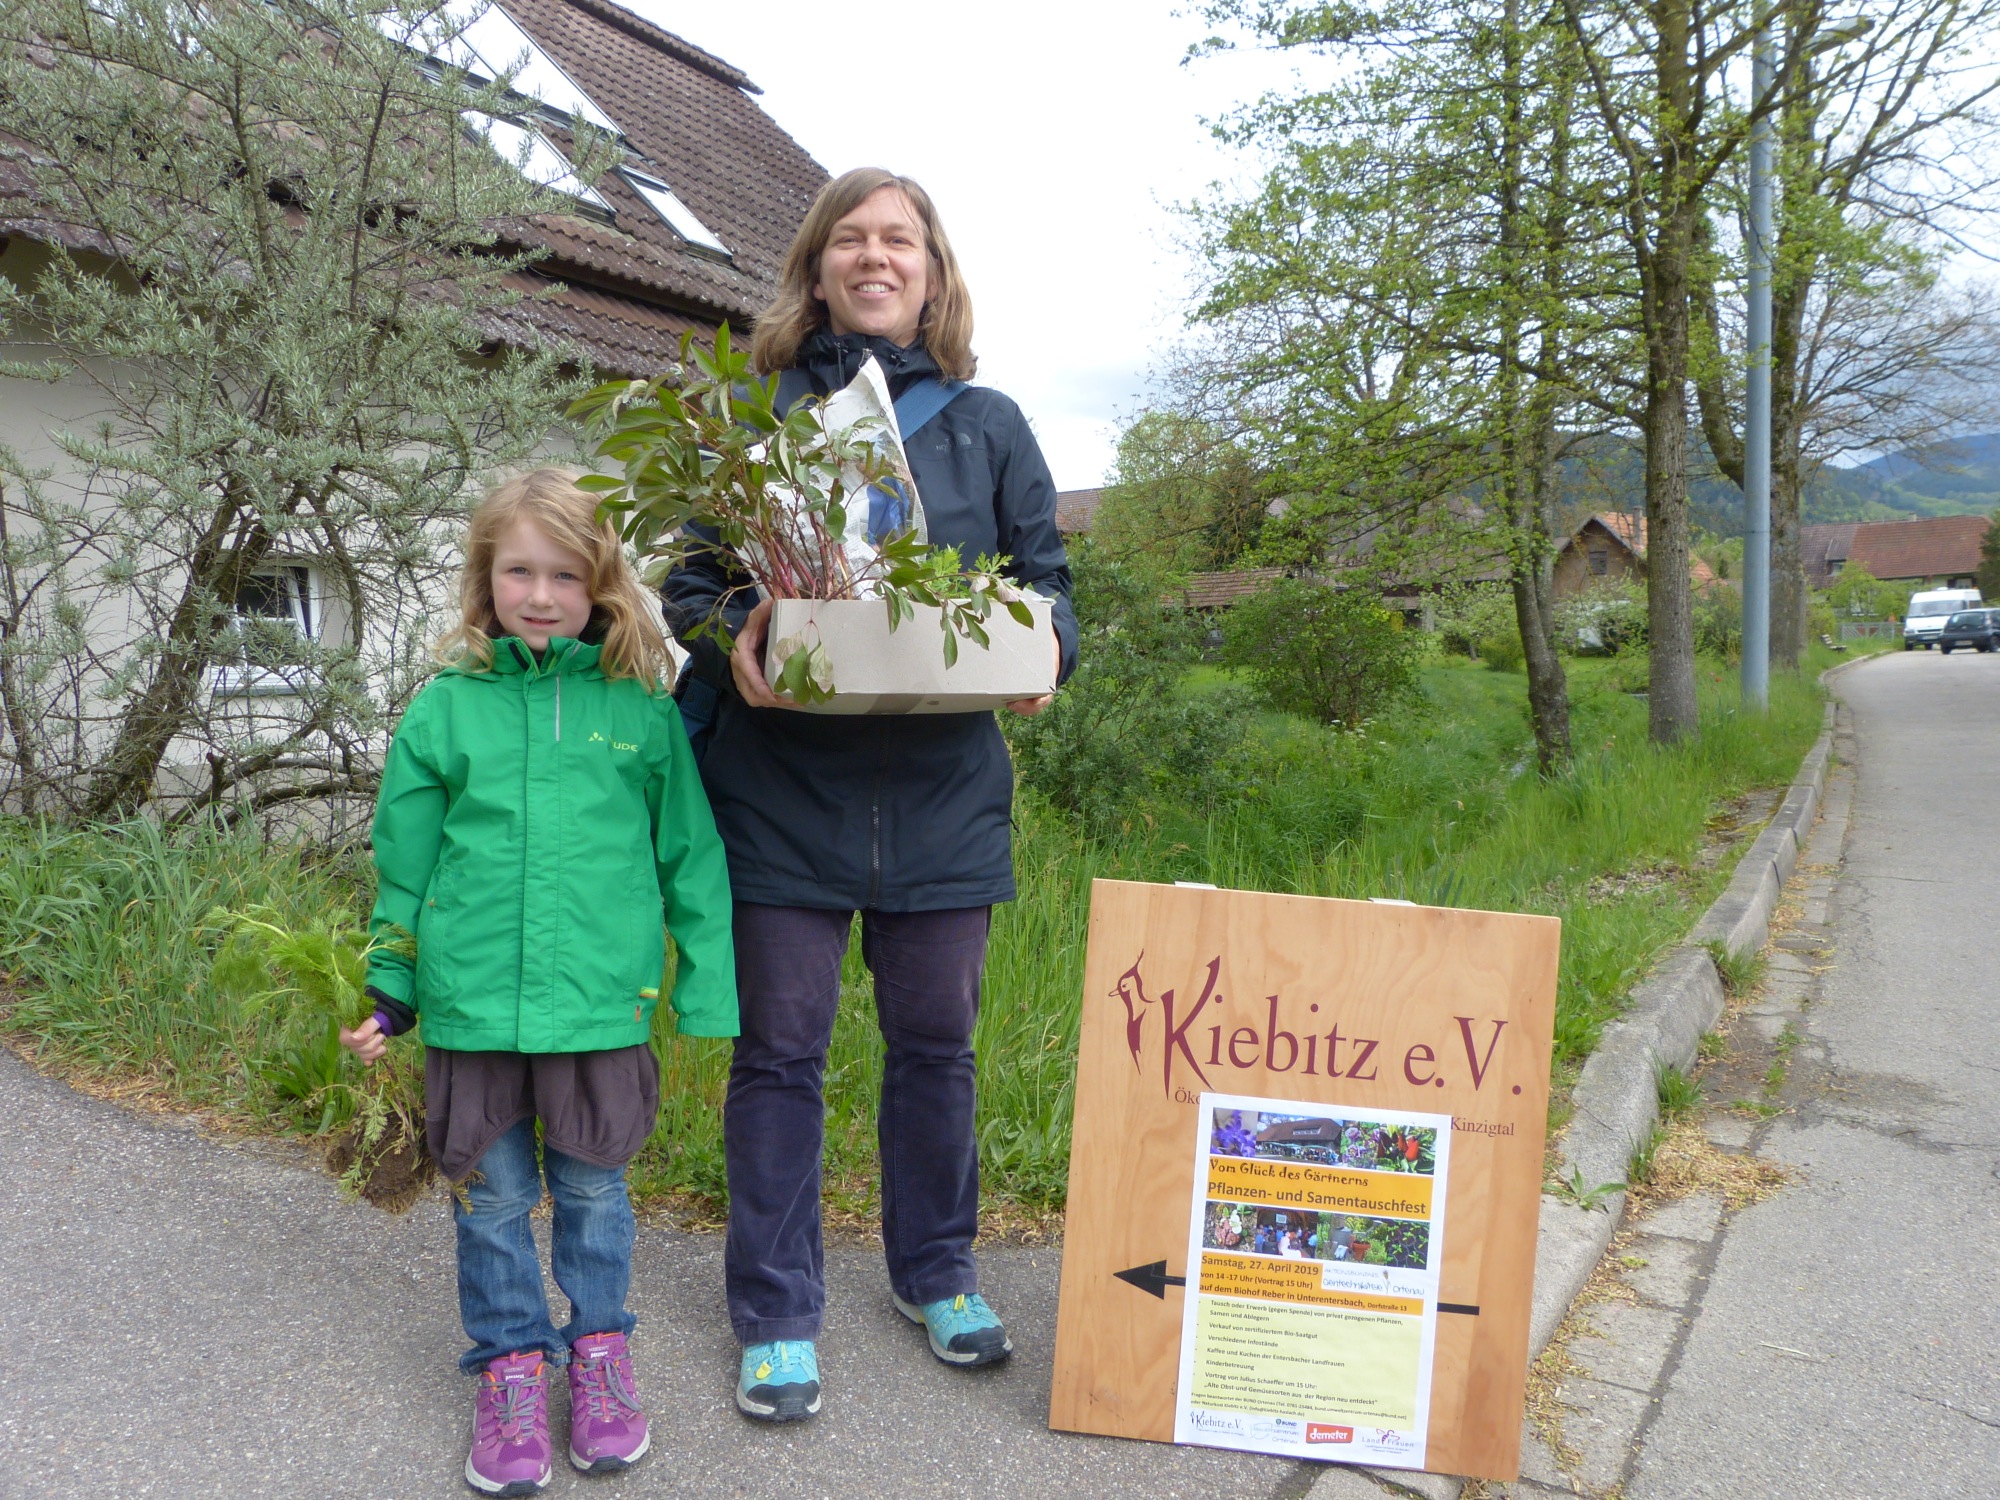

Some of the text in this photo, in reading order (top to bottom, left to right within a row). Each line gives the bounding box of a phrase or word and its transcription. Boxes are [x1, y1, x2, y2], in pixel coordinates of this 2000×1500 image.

[1160, 954, 1523, 1100] Kiebitz e.V.
[1450, 1116, 1515, 1138] Kinzigtal
[1209, 1158, 1369, 1187] Vom Glück des Gärtnerns
[1208, 1181, 1426, 1214] Pflanzen- und Samentauschfest
[1201, 1255, 1319, 1276] Samstag, 27. April 2019
[1216, 1272, 1225, 1280] 14
[1226, 1273, 1238, 1281] -17
[1239, 1274, 1254, 1283] Uhr
[1254, 1276, 1285, 1288] (Vortrag
[1286, 1279, 1295, 1287] 15
[1296, 1280, 1313, 1291] Uhr)
[1199, 1283, 1213, 1292] auf
[1214, 1284, 1232, 1294] dem
[1233, 1286, 1261, 1296] Biohof
[1261, 1289, 1286, 1299] Reber
[1286, 1291, 1295, 1300] in
[1296, 1293, 1366, 1309] Unterentersbach,
[1209, 1309, 1230, 1317] Samen
[1243, 1313, 1270, 1322] Ablegern
[1211, 1299, 1231, 1308] Tausch
[1246, 1303, 1268, 1312] Erwerb
[1268, 1306, 1288, 1314] (gegen
[1288, 1308, 1313, 1317] Spende)
[1325, 1312, 1344, 1320] privat
[1344, 1314, 1376, 1323] gezogenen
[1376, 1317, 1403, 1326] Pflanzen,
[1208, 1322, 1232, 1330] Verkauf
[1244, 1326, 1283, 1335] zertifiziertem
[1284, 1330, 1318, 1340] Bio-Saatgut
[1207, 1334, 1279, 1348] Verschiedene Infostände
[1205, 1359, 1255, 1371] Kinderbetreuung
[1206, 1347, 1226, 1355] Kaffee
[1239, 1350, 1261, 1359] Kuchen
[1272, 1354, 1311, 1364] Entersbacher
[1311, 1358, 1345, 1368] Landfrauen
[1204, 1371, 1227, 1381] Vortrag
[1239, 1375, 1256, 1383] Julius
[1256, 1377, 1284, 1386] Schaeffer
[1296, 1381, 1304, 1389] 15
[1248, 1386, 1291, 1397] Gemüsesorten
[1315, 1394, 1336, 1402] Region
[1196, 1410, 1226, 1429] Kiebitz
[1309, 1428, 1349, 1440] demeter
